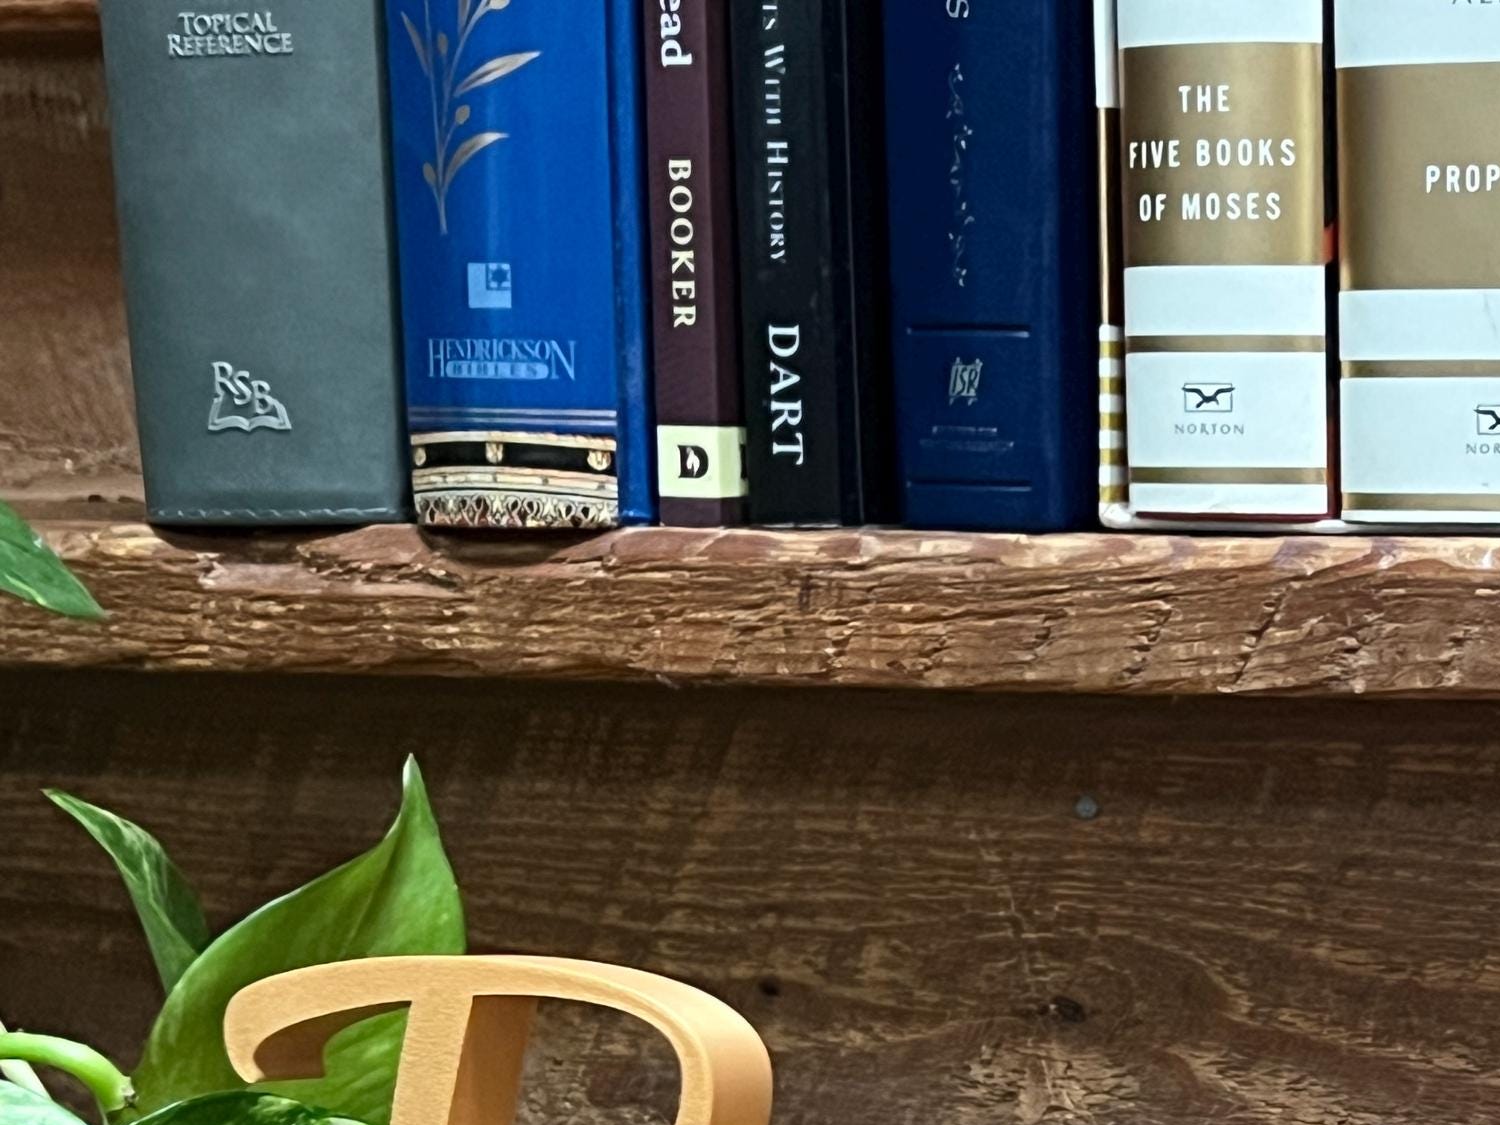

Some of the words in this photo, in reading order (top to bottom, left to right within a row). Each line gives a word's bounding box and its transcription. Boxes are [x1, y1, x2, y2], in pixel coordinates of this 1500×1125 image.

[178, 11, 278, 34] TOPICAL
[167, 33, 293, 56] REFERENCE
[1178, 85, 1231, 113] THE
[1128, 140, 1181, 169] FIVE
[1196, 138, 1297, 167] BOOKS
[1138, 194, 1166, 222] OF
[1181, 191, 1282, 221] MOSES
[668, 159, 696, 328] BOOKER
[428, 338, 577, 381] HENDRICKSON
[211, 361, 274, 415] RSB
[768, 325, 804, 467] DART
[1174, 423, 1245, 437] NORTON
